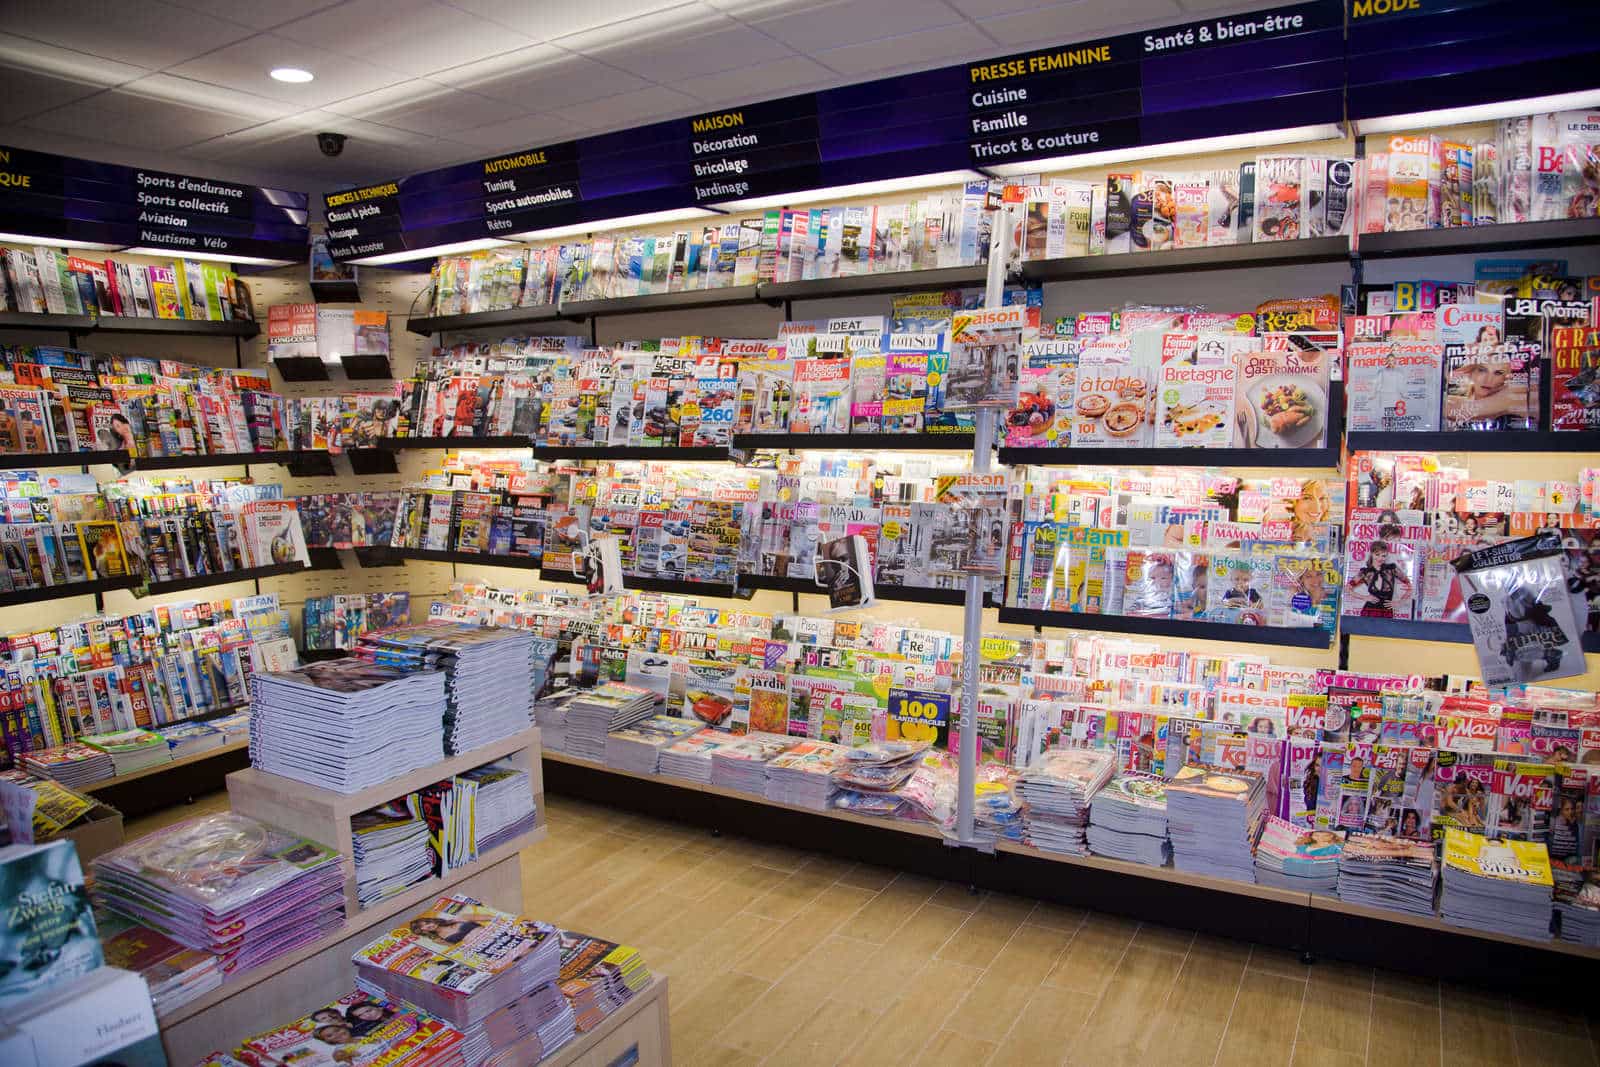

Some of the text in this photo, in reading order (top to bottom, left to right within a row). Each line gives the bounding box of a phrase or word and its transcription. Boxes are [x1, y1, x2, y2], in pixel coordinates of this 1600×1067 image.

[1352, 0, 1420, 18] MODE
[1144, 14, 1304, 52] Santé & bien-être
[971, 46, 1112, 83] PRESSE FEMININE
[972, 87, 1027, 107] Cuisine
[693, 112, 744, 133] MAISON
[972, 112, 1028, 134] Famille
[693, 133, 758, 154] Décoration
[971, 129, 1099, 158] Tricot & couture
[485, 152, 547, 175] AUTOMOBILE
[694, 157, 749, 176] Bricolage
[137, 173, 243, 198] Sports d'endurance
[484, 178, 516, 193] Tuning
[695, 180, 749, 200] Jardinage
[137, 192, 230, 214] Sports collectifs
[328, 190, 354, 207] SCIENCES
[360, 183, 398, 200] TECHNIQUES
[486, 187, 572, 214] Sports automobiles
[139, 212, 188, 227] Aviation
[328, 209, 351, 222] Chasse
[351, 209, 358, 220] &
[487, 218, 512, 231] Rétro
[141, 231, 228, 249] Nautisme Vélo
[329, 227, 359, 240] Musique
[829, 320, 862, 330] IDEAT
[972, 308, 1020, 325] aison
[1026, 342, 1081, 354] AVEUR
[1095, 376, 1142, 393] table
[1165, 367, 1234, 384] Bretagne
[702, 408, 734, 422] 260
[957, 474, 1004, 486] aison
[1512, 512, 1577, 530] GRAIA
[1214, 528, 1258, 540] MAMAN
[752, 677, 786, 690] jardin
[898, 700, 938, 720] 100
[1455, 720, 1497, 738] Maxi
[18, 881, 76, 905] Stefan
[8, 902, 65, 928] Zweig
